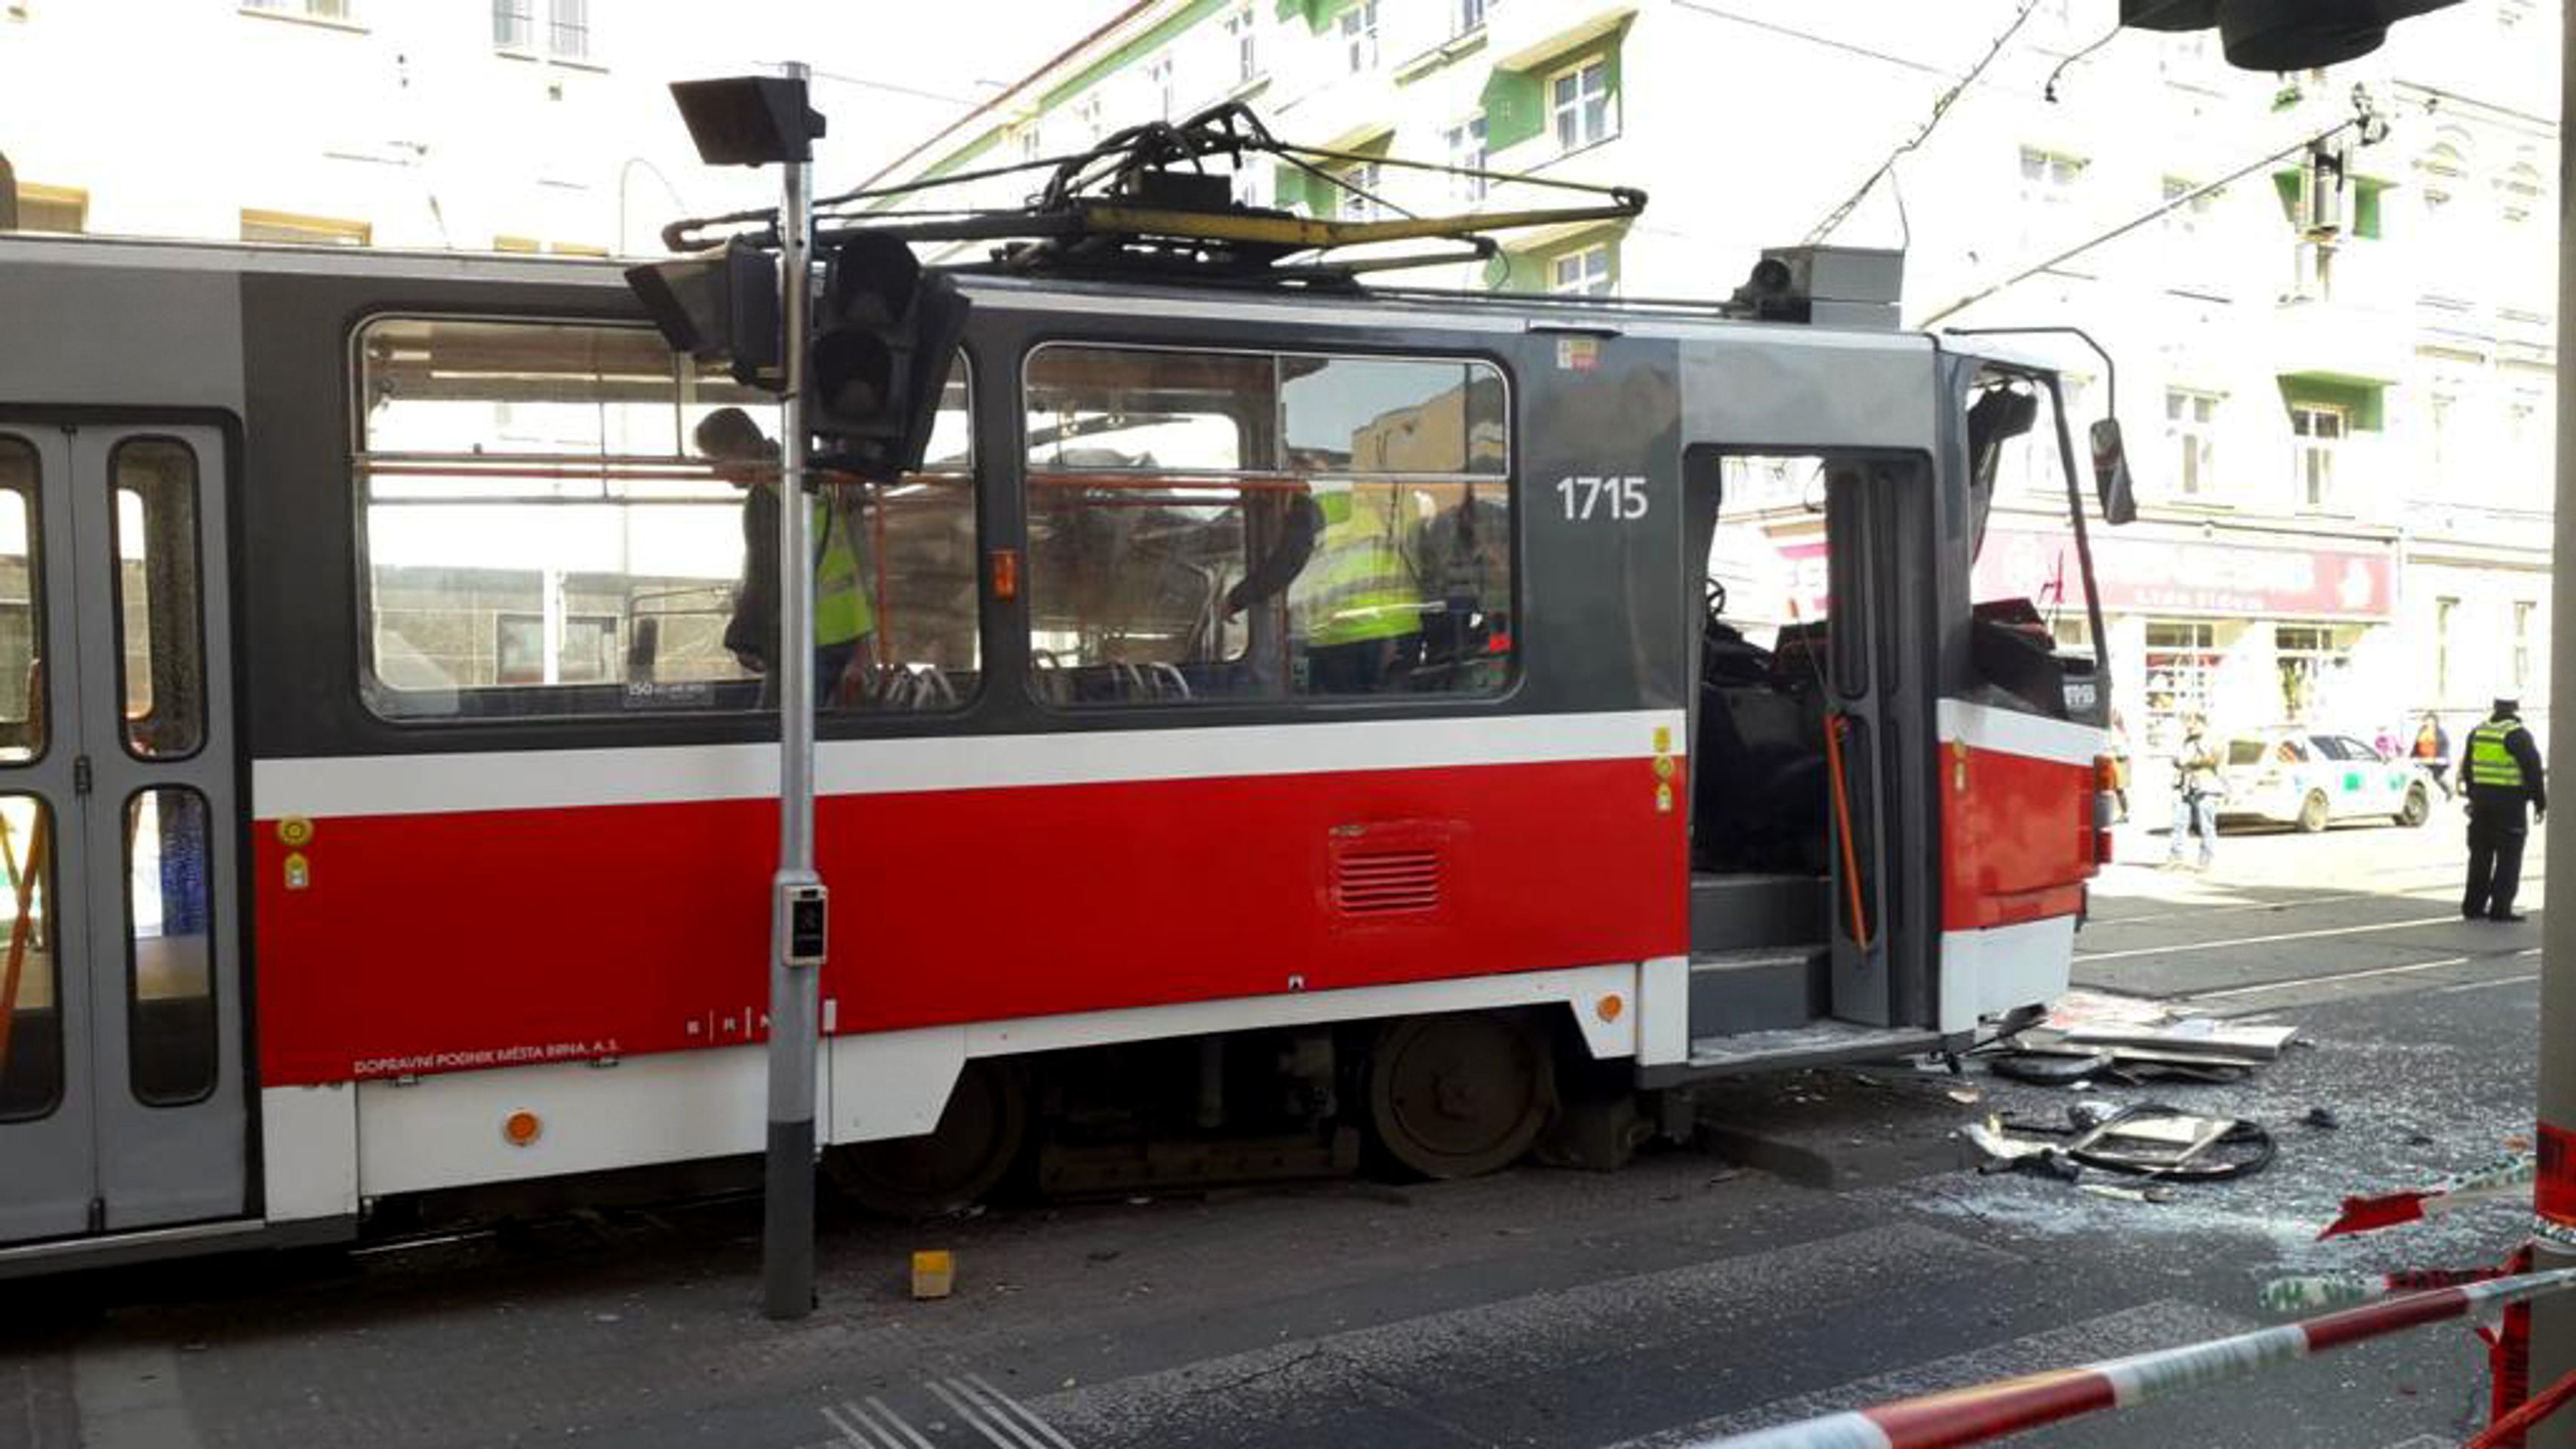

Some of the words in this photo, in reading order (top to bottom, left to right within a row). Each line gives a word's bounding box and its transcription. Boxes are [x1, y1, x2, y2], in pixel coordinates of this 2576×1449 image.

[1556, 476, 1648, 520] 1715
[353, 1054, 434, 1073] DOPRAVNÍ
[436, 1051, 494, 1067] PODNIK
